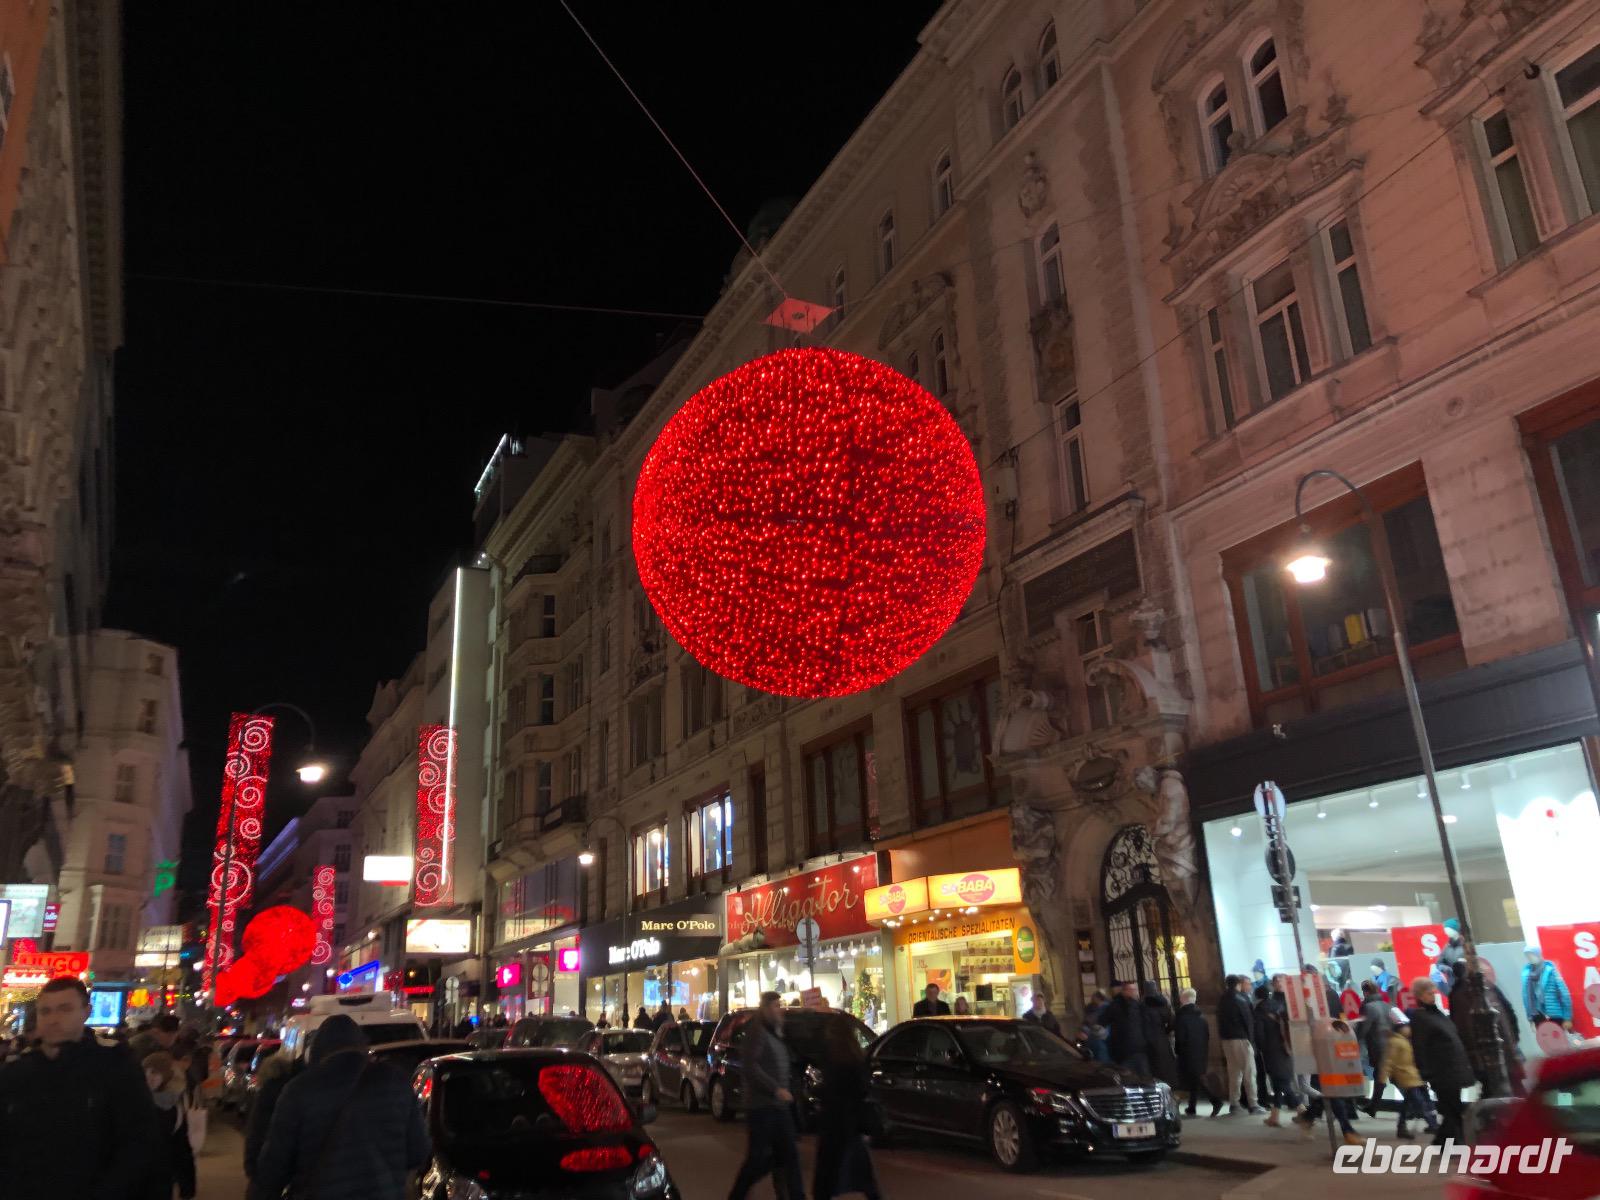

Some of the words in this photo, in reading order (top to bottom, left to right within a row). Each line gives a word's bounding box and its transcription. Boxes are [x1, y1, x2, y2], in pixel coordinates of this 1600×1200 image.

[741, 875, 859, 935] Alligator
[641, 920, 673, 930] Marc
[676, 920, 715, 930] O'Polo
[908, 927, 957, 944] ORIENTALISCHE
